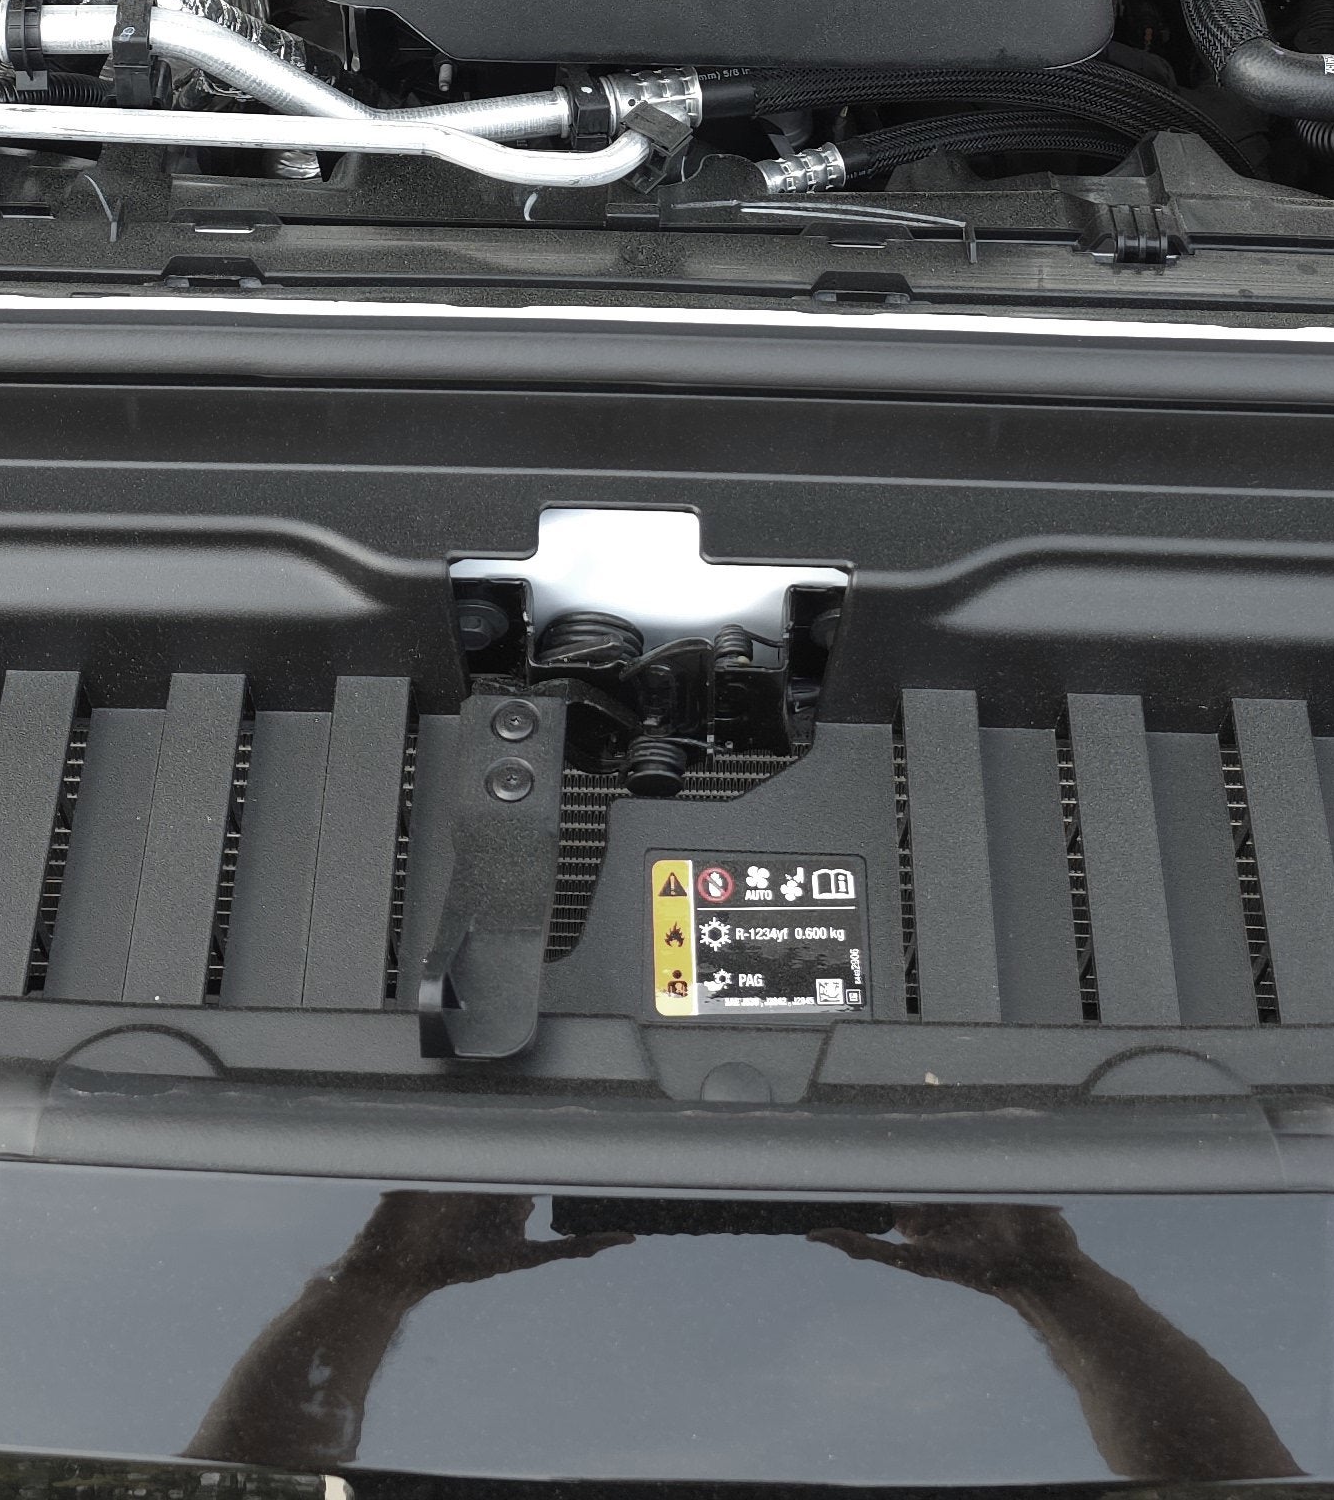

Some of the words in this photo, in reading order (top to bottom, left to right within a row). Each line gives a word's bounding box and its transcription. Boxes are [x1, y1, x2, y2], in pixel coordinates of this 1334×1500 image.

[745, 889, 773, 901] AUTO
[735, 927, 788, 942] R-1234yf
[794, 927, 827, 940] 0.600
[830, 927, 846, 942] kg
[738, 973, 763, 988] PAG
